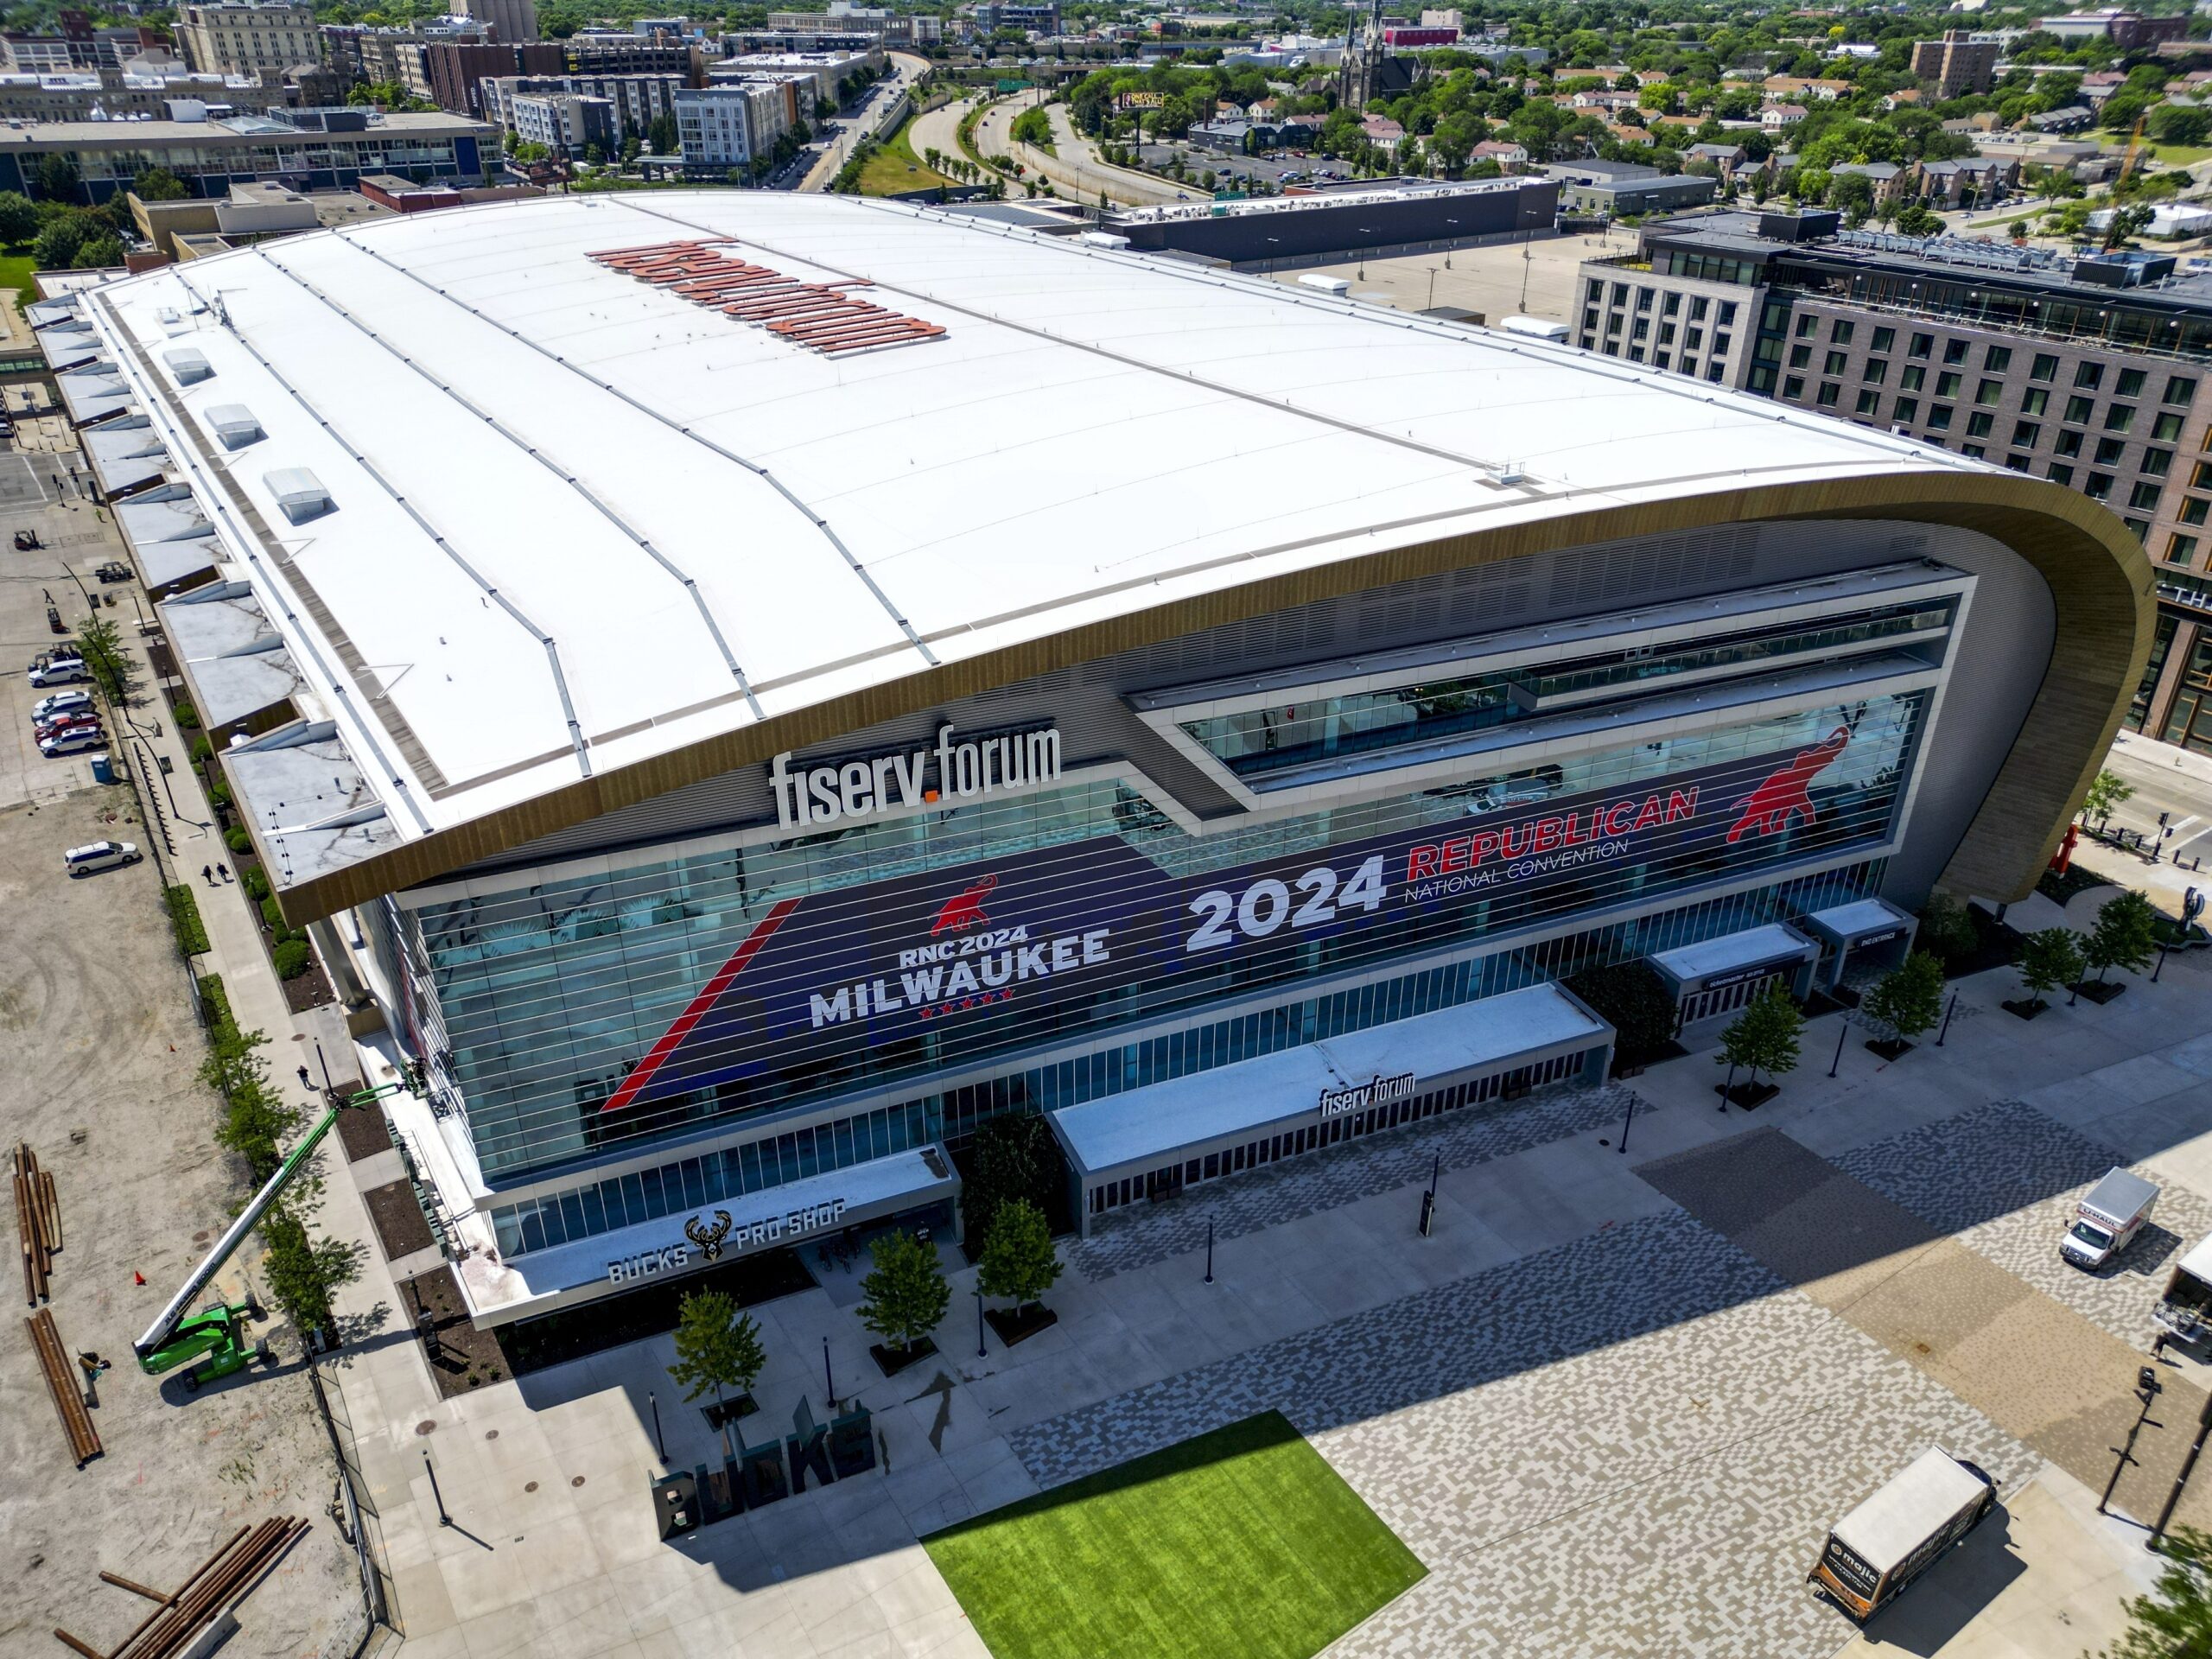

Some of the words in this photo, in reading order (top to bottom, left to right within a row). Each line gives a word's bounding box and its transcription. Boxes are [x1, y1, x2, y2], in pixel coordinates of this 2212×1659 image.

[1408, 785, 1700, 882] REPUBLICAN
[1186, 855, 1387, 951] 2024
[1405, 869, 1501, 903] NATIONAL
[1507, 839, 1629, 879] CONVENTION
[810, 928, 1109, 1027] MILWAUKEE
[899, 941, 956, 969] RNC
[958, 925, 1028, 956] 2024
[608, 1244, 689, 1285] BUCKS
[736, 1219, 780, 1249] PRO
[787, 1199, 846, 1235] SHOP
[2083, 1208, 2116, 1227] U-HAUL
[164, 1310, 177, 1326] JLG
[1843, 1552, 1877, 1584] majic
